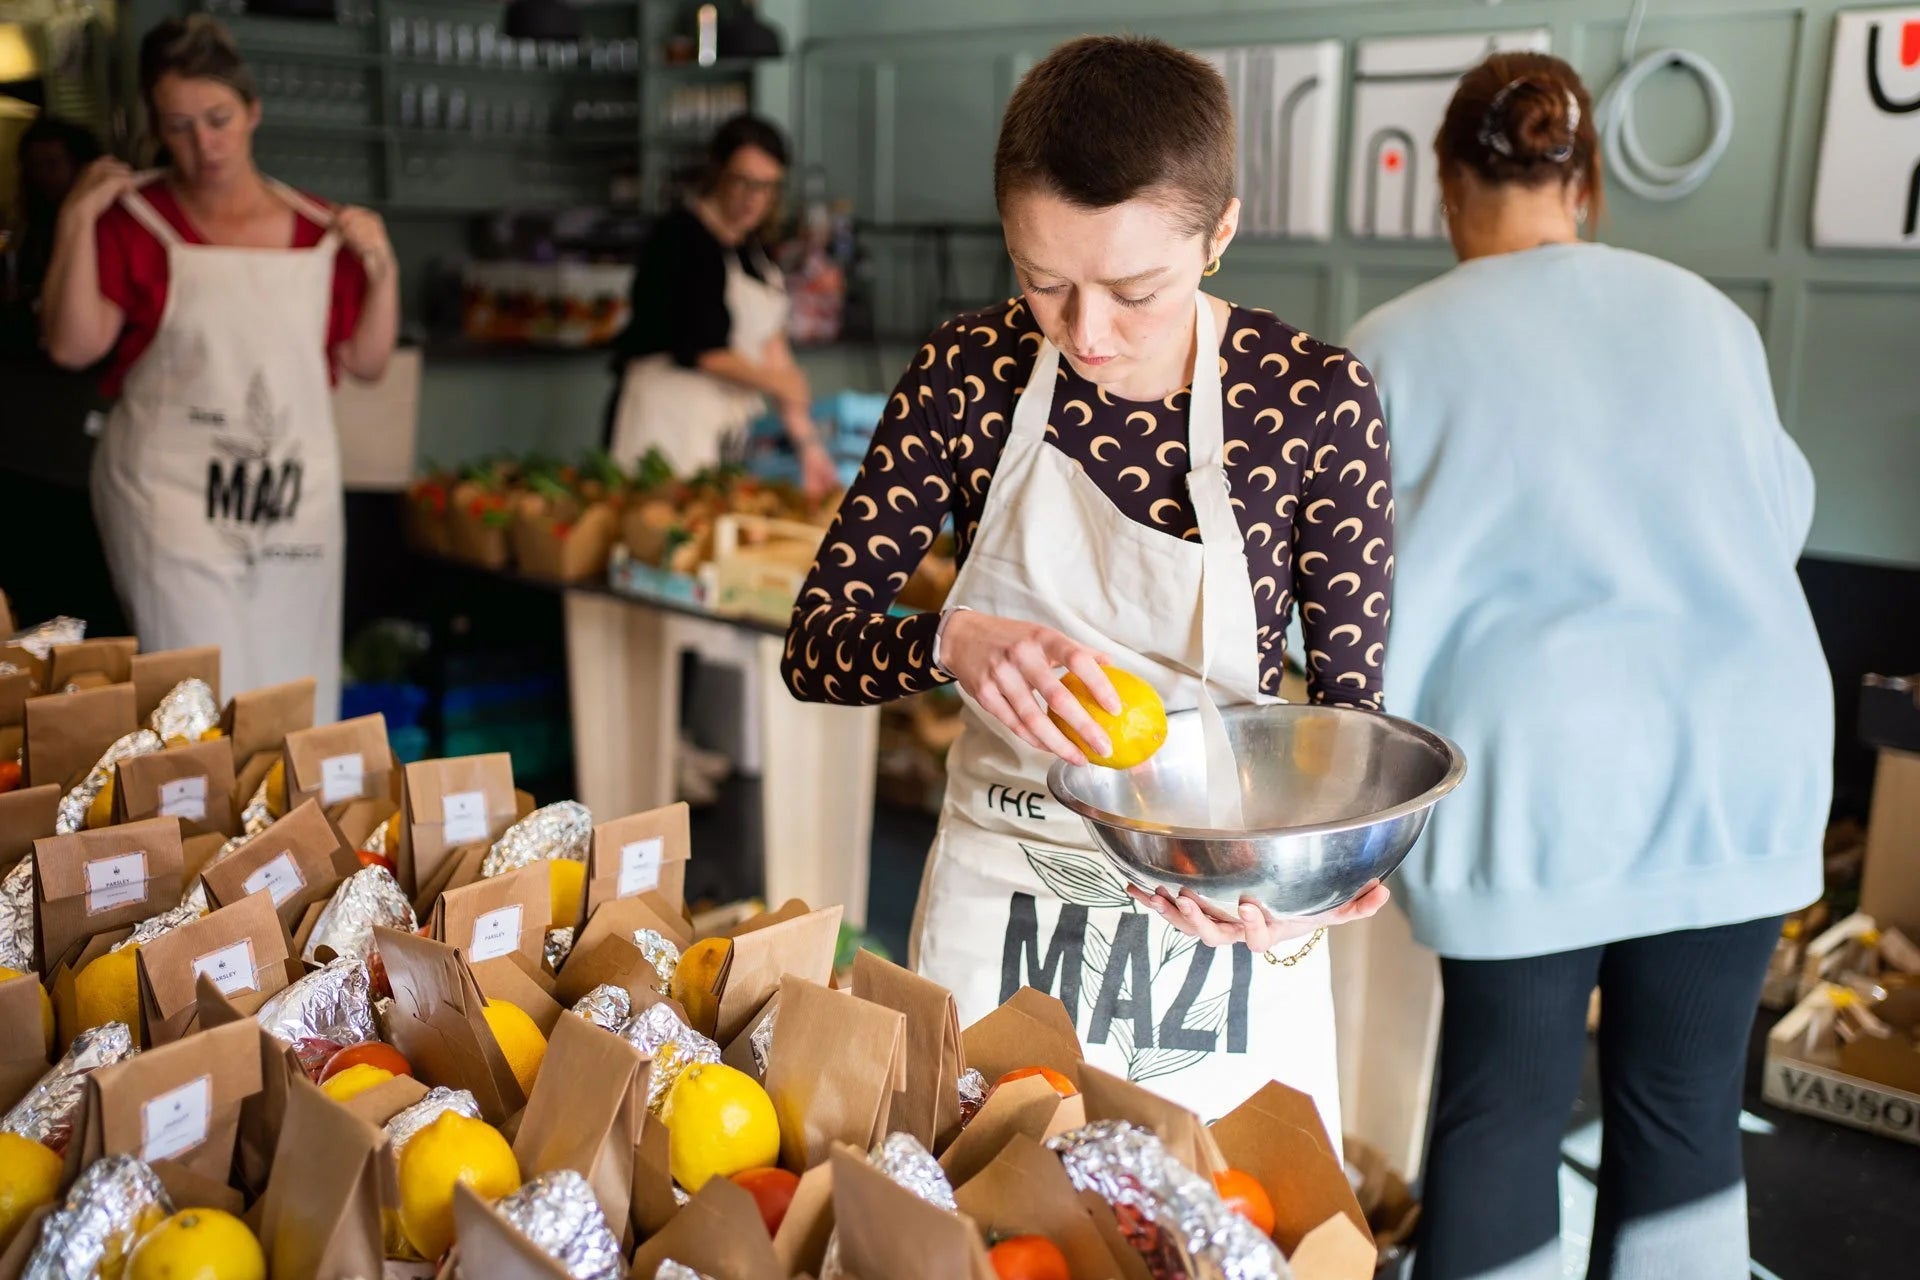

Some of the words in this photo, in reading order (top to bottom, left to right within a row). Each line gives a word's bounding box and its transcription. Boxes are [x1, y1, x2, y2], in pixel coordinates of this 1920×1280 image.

[988, 783, 1046, 820] THE
[106, 879, 130, 889] PARSLEY
[213, 970, 236, 982] ARSLEY
[998, 891, 1253, 1054] MAZI
[1780, 1066, 1920, 1132] VASSO
